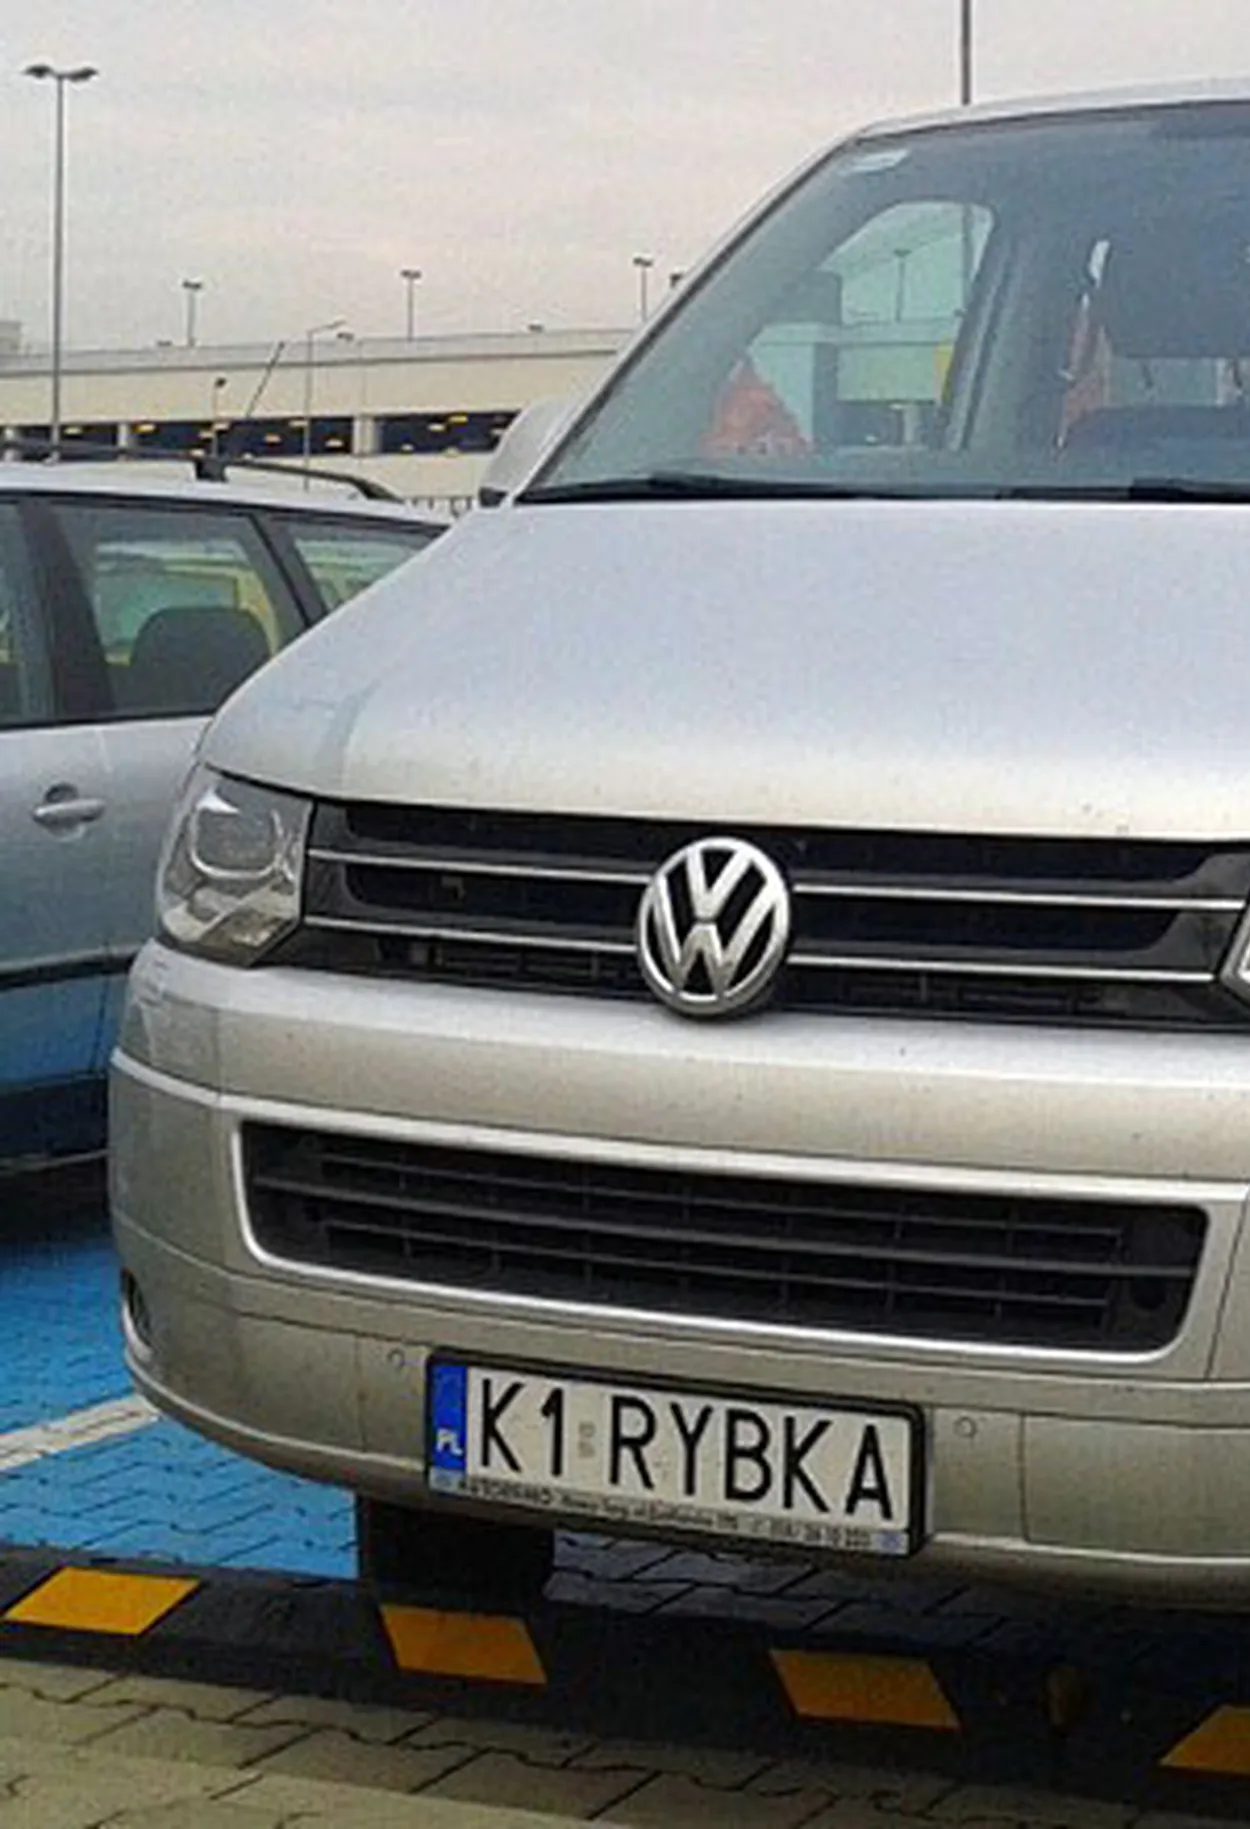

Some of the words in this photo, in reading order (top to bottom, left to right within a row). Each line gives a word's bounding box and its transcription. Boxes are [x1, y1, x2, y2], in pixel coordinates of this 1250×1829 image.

[436, 1428, 464, 1457] PL
[481, 1377, 565, 1477] K1
[609, 1395, 893, 1520] RYBKA
